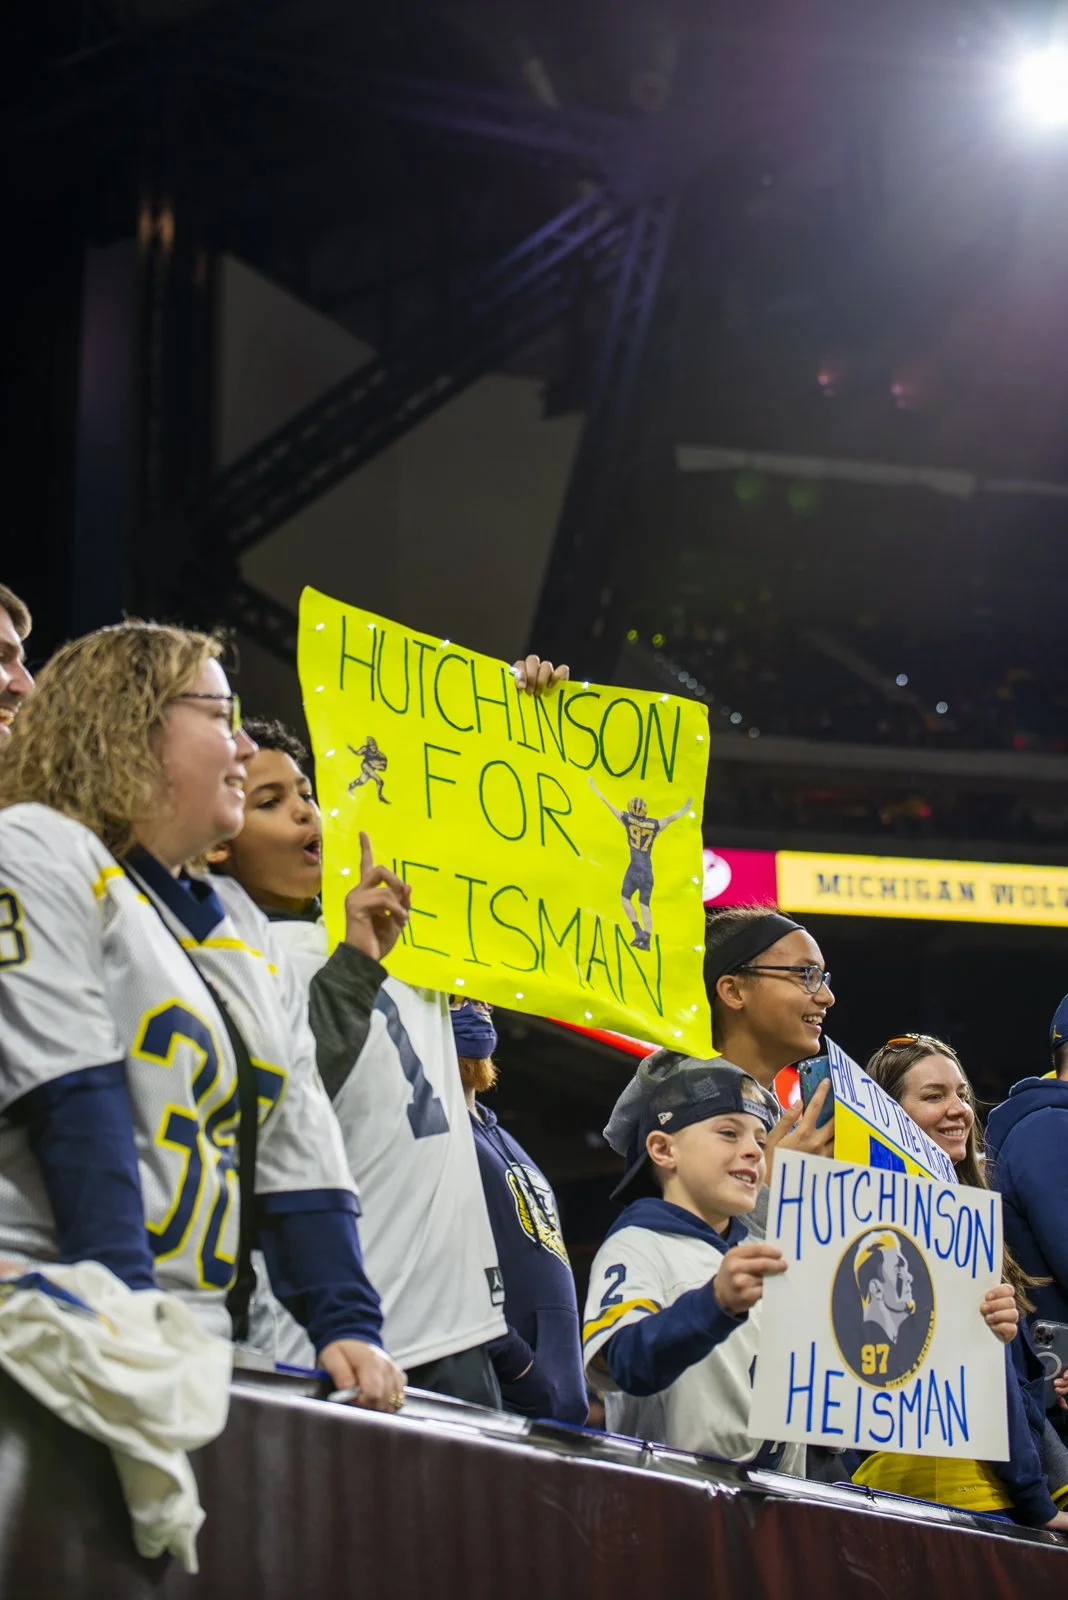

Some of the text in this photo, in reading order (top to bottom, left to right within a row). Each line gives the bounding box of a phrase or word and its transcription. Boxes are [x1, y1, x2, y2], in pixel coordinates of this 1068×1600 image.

[339, 615, 681, 783] HUTCHINSON
[423, 742, 581, 856] FOR
[629, 825, 654, 852] 97
[816, 873, 976, 902] MICHIGAN
[826, 1040, 865, 1109] HAIL
[861, 1078, 889, 1128] TO
[887, 1098, 921, 1153] THE
[776, 1159, 995, 1279] HUTCHINSON
[600, 1263, 627, 1305] 2
[786, 1341, 970, 1449] HEISMAN
[861, 1343, 890, 1375] 97
